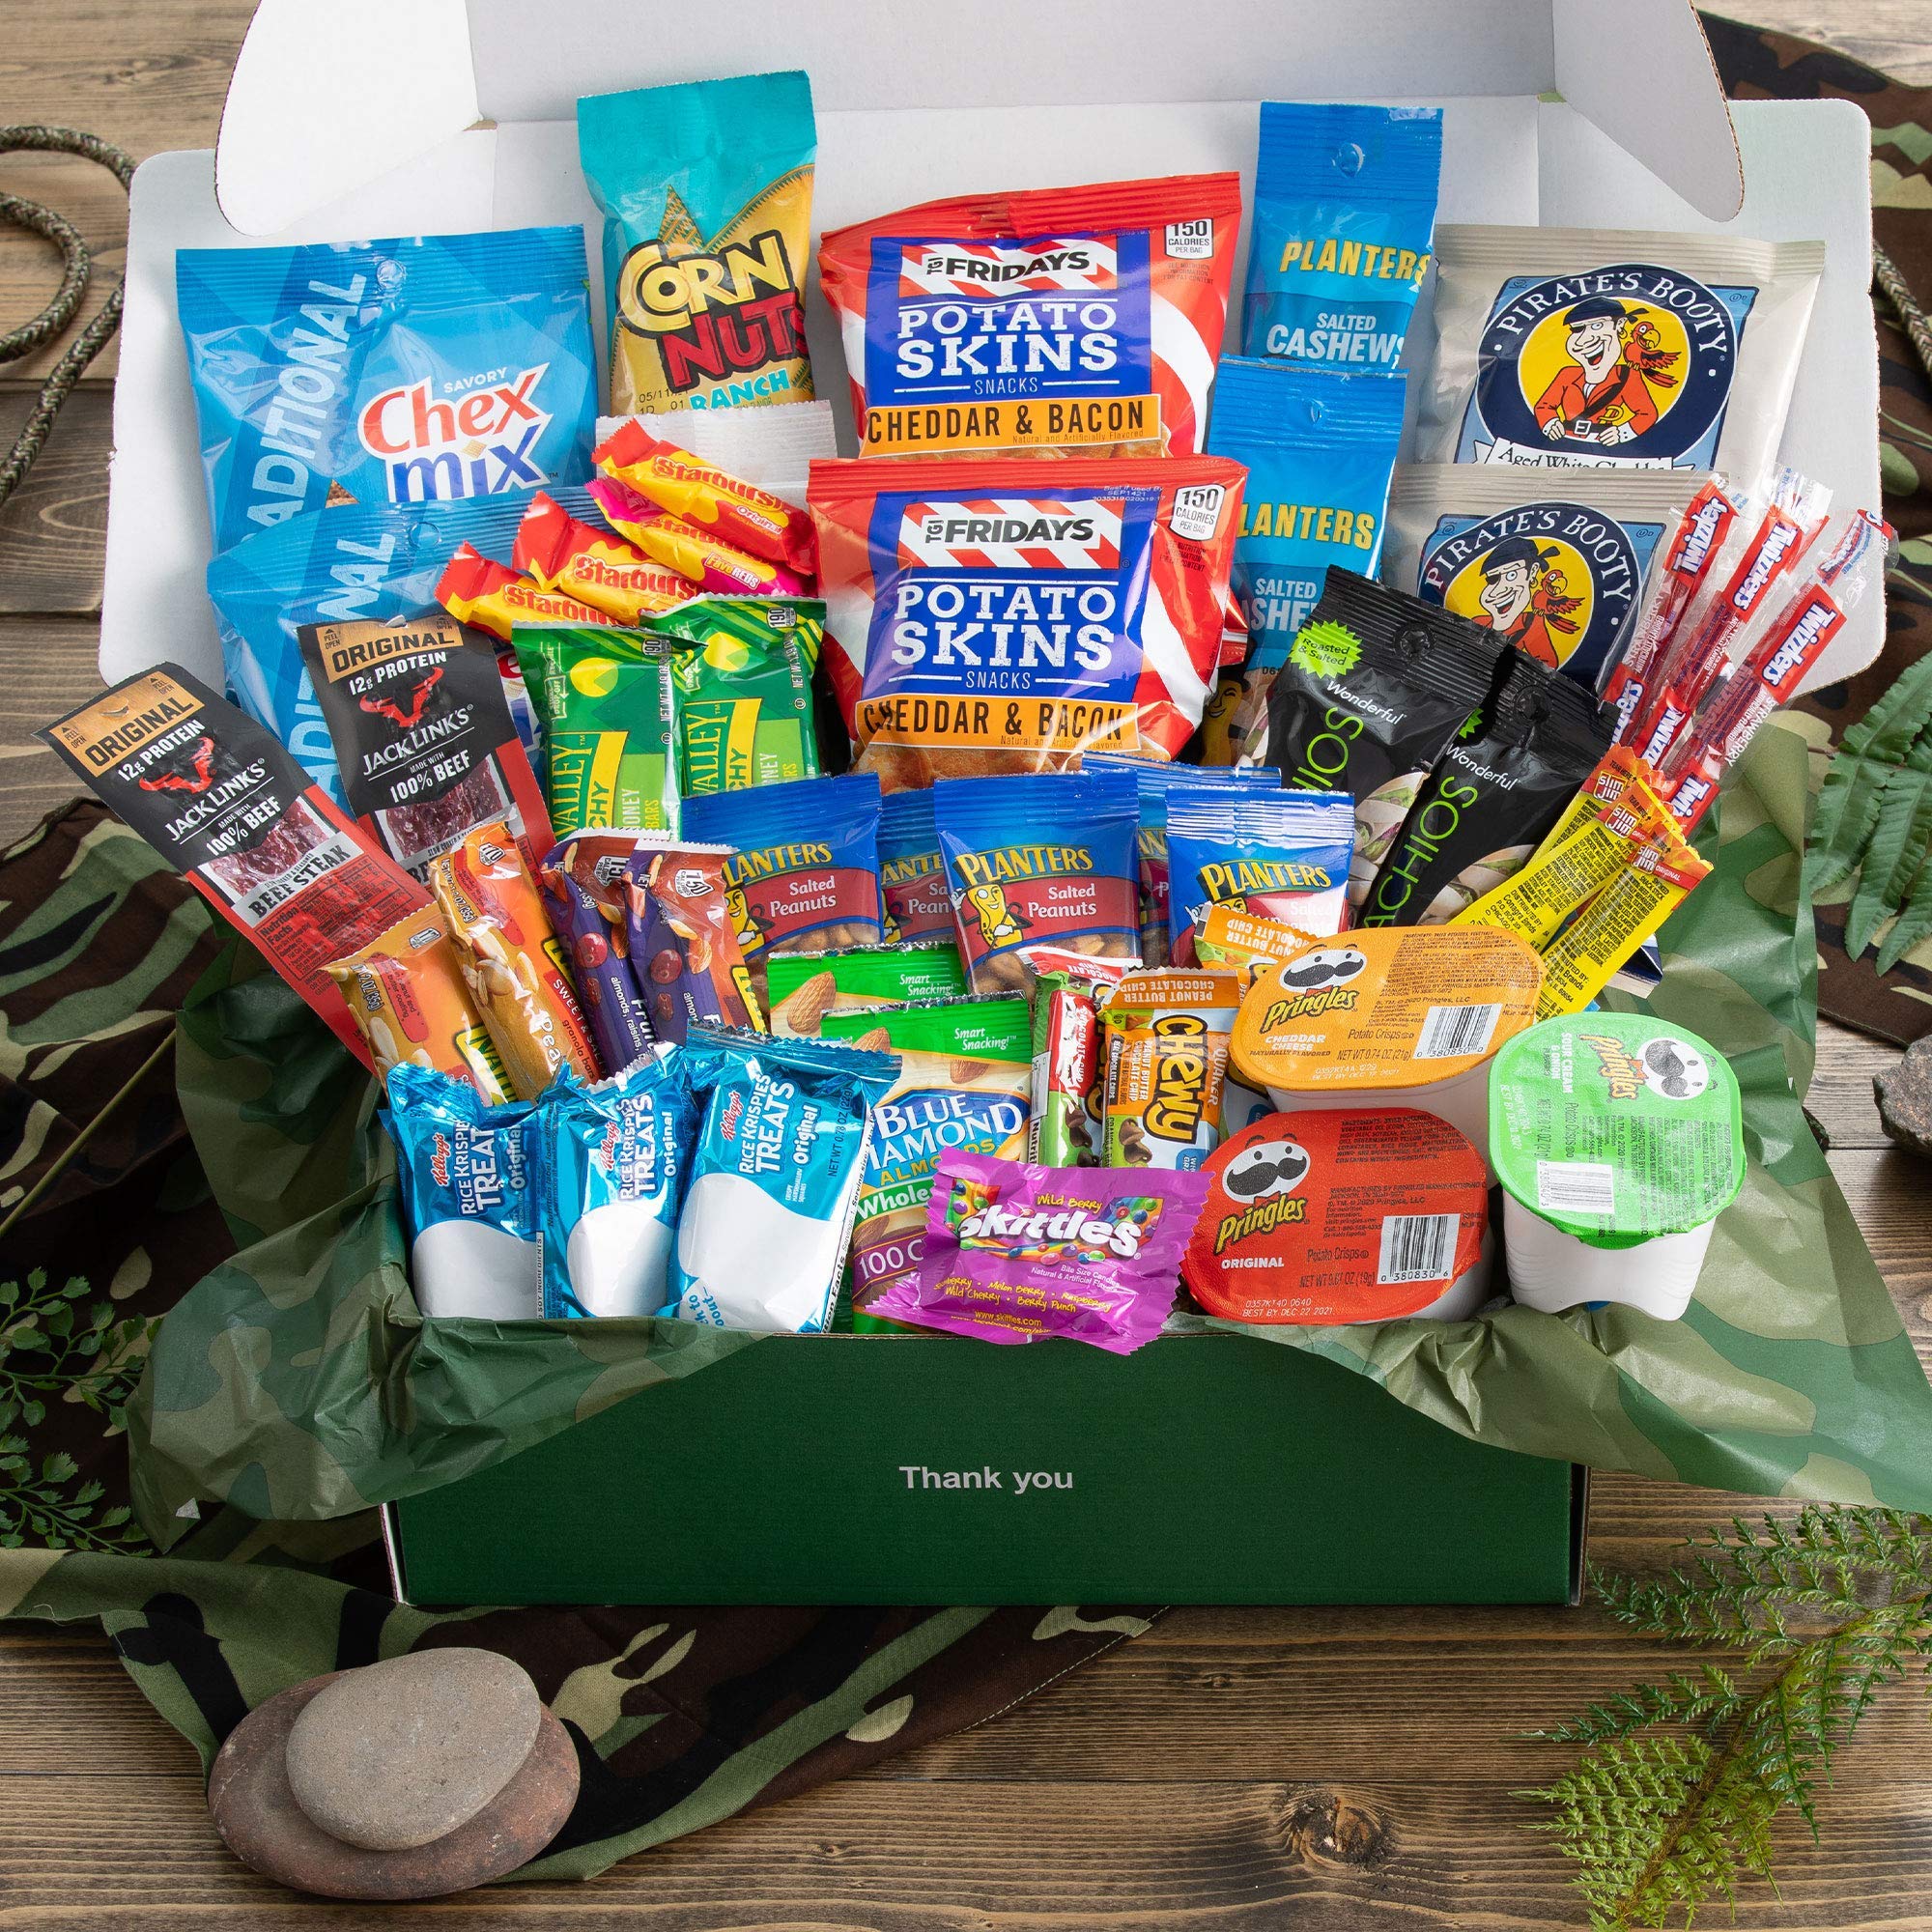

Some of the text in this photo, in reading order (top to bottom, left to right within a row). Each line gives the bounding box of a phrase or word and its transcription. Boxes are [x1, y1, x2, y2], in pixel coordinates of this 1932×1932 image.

[1168, 238, 1209, 246] CALORIES
[1171, 220, 1208, 237] 150
[620, 237, 790, 330] CORN
[926, 251, 1090, 284] TGI FRIDAYS
[897, 303, 1117, 339] POTATO
[1317, 312, 1377, 331] SALTED
[1495, 271, 1727, 354] PIRATE'S BOOTY
[896, 333, 1118, 378] SKINS
[443, 367, 508, 394] SAVORY
[690, 369, 790, 410] RANCH
[975, 378, 1038, 395] SNACKS
[362, 362, 544, 456] Chex
[868, 401, 1143, 443] CHEDDAR & BACON
[1012, 436, 1042, 444] Natural
[1109, 430, 1144, 440] Flavored
[391, 425, 542, 501] mix
[1182, 488, 1219, 511] 150
[737, 506, 782, 534] Original
[926, 519, 1094, 544] TGI FRIDAYS
[1176, 507, 1215, 525] CALORIES
[1424, 510, 1633, 604] PIRATE'S BOOTY
[1734, 525, 1798, 611] Twizzlers
[894, 584, 1117, 622] POTATO
[1256, 579, 1317, 599] SALTED
[769, 608, 785, 627] 190
[332, 632, 455, 673] ORIGINAL
[645, 639, 661, 655] 190
[891, 622, 1115, 670] SKINS
[1302, 638, 1350, 654] Roasted
[1310, 649, 1347, 666] Salted
[1762, 603, 1836, 687] Twizzlers
[350, 651, 447, 696] 12g PROTEIN
[966, 671, 1031, 690] SNACKS
[1327, 681, 1403, 724] Wonderful
[85, 696, 193, 767] ORIGINAL
[864, 699, 1122, 740] CHEDDAR & BACON
[1724, 696, 1777, 767] STRAWBERRY
[118, 719, 206, 782] 12g PROTEIN
[363, 706, 471, 776] JACK LINK'S
[1000, 735, 1031, 746] Natural
[427, 751, 445, 766] WITH
[1447, 744, 1519, 791] Wonderful
[390, 750, 470, 803] 100% BEEF
[550, 743, 593, 838] VALLEY
[164, 761, 267, 841] JACK LINK'S
[206, 795, 281, 857] 100% BEEF
[218, 815, 236, 829] MADE
[248, 883, 295, 919] BEEF
[294, 844, 352, 886] STEAK
[956, 846, 1093, 886] PLANTERS
[1200, 862, 1332, 901] PLANTERS
[1656, 865, 1681, 880] ORIGINAL
[789, 876, 836, 896] Salted
[1048, 883, 1095, 900] Salted
[260, 907, 299, 936] Nutrition
[770, 895, 837, 918] Peanuts
[1028, 901, 1097, 919] Peanuts
[268, 924, 294, 945] Facts
[1226, 931, 1268, 952] BUTTER
[1227, 920, 1253, 934] CHIP
[899, 973, 930, 985] Smart
[1120, 980, 1215, 993] CHOCOLATE CHIP
[553, 979, 585, 1027] SWEET
[611, 976, 631, 1018] almonds,
[1123, 991, 1213, 1003] PEANUT BUTTER
[1260, 991, 1359, 1034] Pringles
[562, 1019, 596, 1079] granola bars
[626, 1019, 641, 1052] raisins,
[954, 1027, 985, 1039] Smart
[962, 1035, 1010, 1050] Snacking!
[1265, 1035, 1325, 1043] CHEDDAR
[1272, 1043, 1314, 1052] CHEESE
[1349, 1029, 1400, 1040] Potato Crisps
[1139, 1041, 1153, 1100] PEANUT BUTTER
[1208, 1047, 1227, 1106] QUAKER
[1551, 1052, 1561, 1080] ONION
[1562, 1033, 1575, 1094] SOUR CREAM
[1577, 1033, 1645, 1100] Pringles
[844, 1086, 855, 1111] (22g)
[723, 1091, 746, 1141] Kellogg's
[740, 1075, 771, 1175] RICE KRISPIES
[756, 1082, 795, 1174] TREATS
[872, 1094, 973, 1139] BLUE
[600, 1121, 621, 1170] Kellogg's
[616, 1097, 635, 1201] RICE KRISPIES
[635, 1094, 656, 1191] TREATS
[664, 1111, 676, 1177] Original
[793, 1103, 819, 1165] Original
[835, 1123, 844, 1144] 0.78
[431, 1133, 451, 1186] Kellogg's
[831, 1145, 840, 1160] WT
[828, 1161, 838, 1178] NET
[458, 1182, 477, 1214] RICE
[859, 1187, 930, 1220] Whole
[1037, 1194, 1064, 1206] Wild
[832, 1173, 865, 1298] Facts Serving
[1213, 1195, 1307, 1255] Pringles
[860, 1250, 902, 1279] 100
[1061, 1264, 1092, 1277] Bite Size
[1221, 1257, 1285, 1269] ORIGINAL
[1334, 1248, 1360, 1262] Crisps
[987, 1281, 1013, 1293] Melon
[1031, 1266, 1092, 1286] Natural Artificial
[945, 1286, 1077, 1314] Wild Punch
[974, 1310, 1042, 1327] www.skittles.com
[899, 1466, 1073, 1494] Thank you
